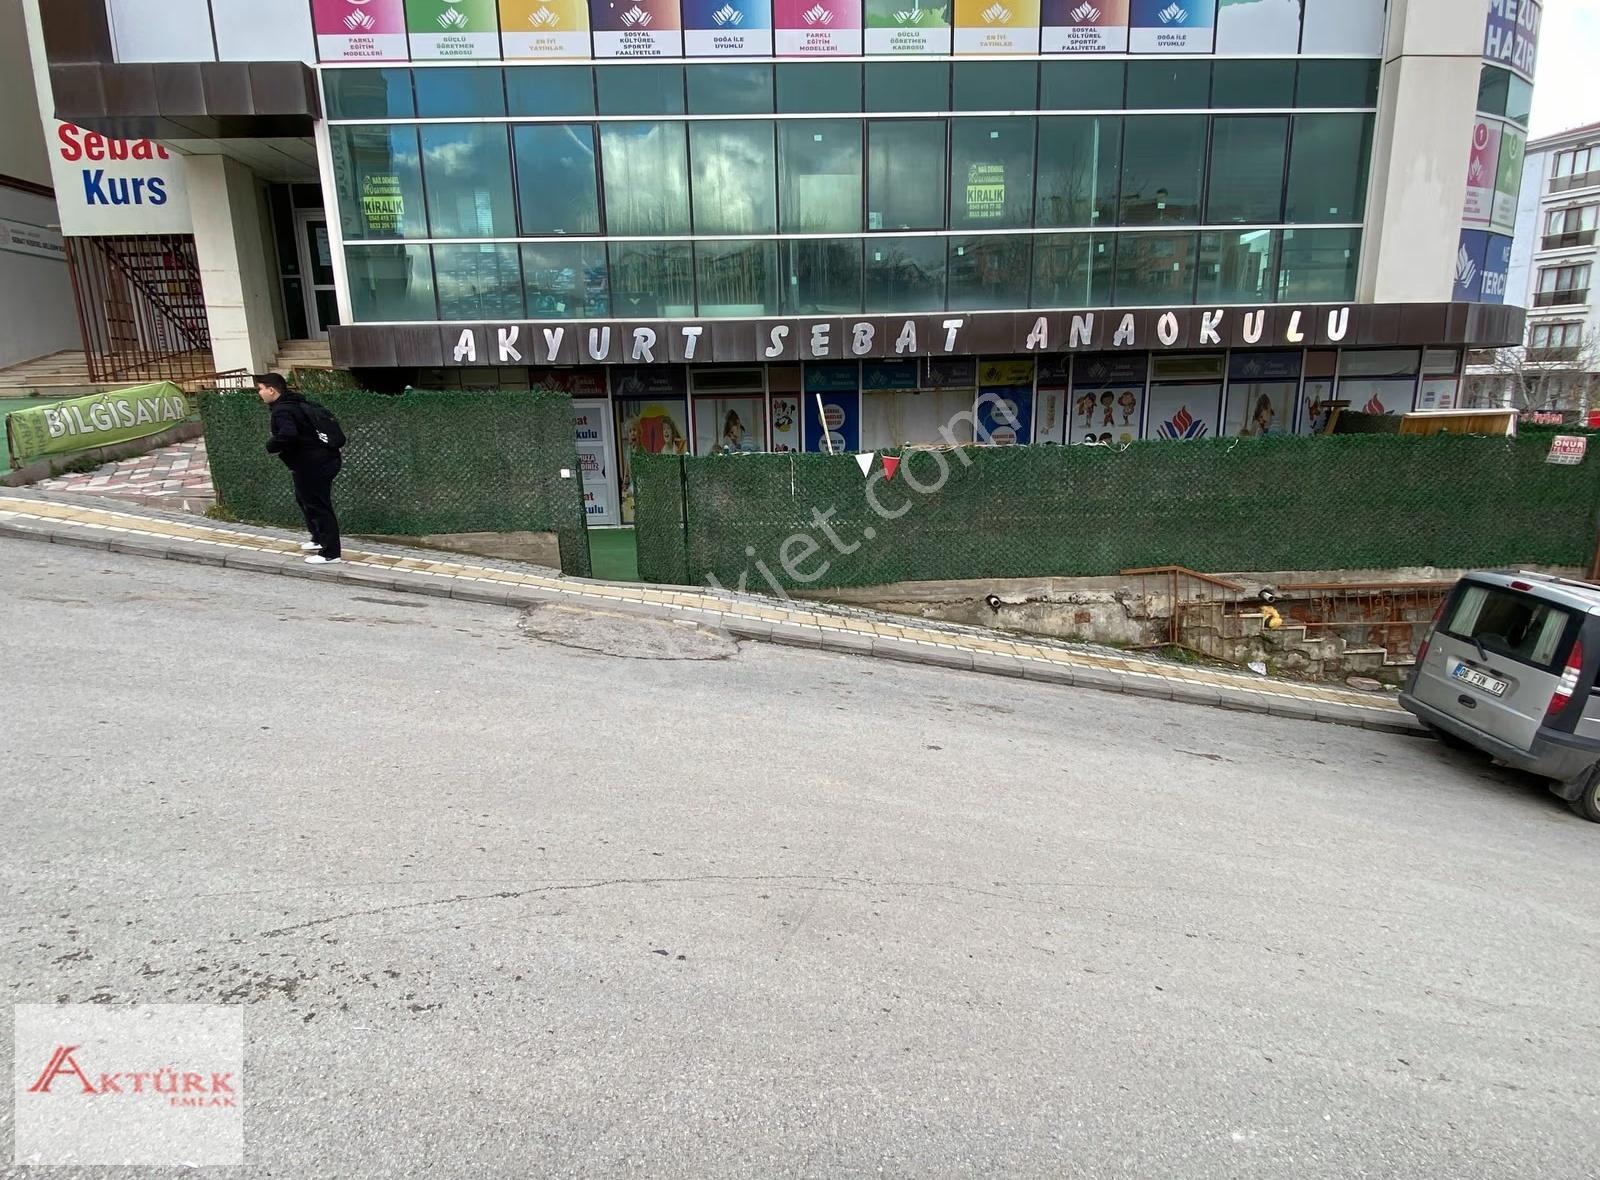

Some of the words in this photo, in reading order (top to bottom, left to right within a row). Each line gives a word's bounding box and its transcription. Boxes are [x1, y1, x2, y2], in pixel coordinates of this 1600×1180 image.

[1486, 25, 1535, 77] HAZIR
[82, 169, 168, 206] Kurs
[967, 187, 1004, 202] KİRALIK
[365, 197, 403, 214] KİRALIK
[453, 325, 703, 363] AKYURT
[765, 318, 964, 358] SEBAT
[1026, 306, 1350, 350] ANAOKULU
[1554, 440, 1584, 448] ONUR
[1459, 667, 1470, 679] 06
